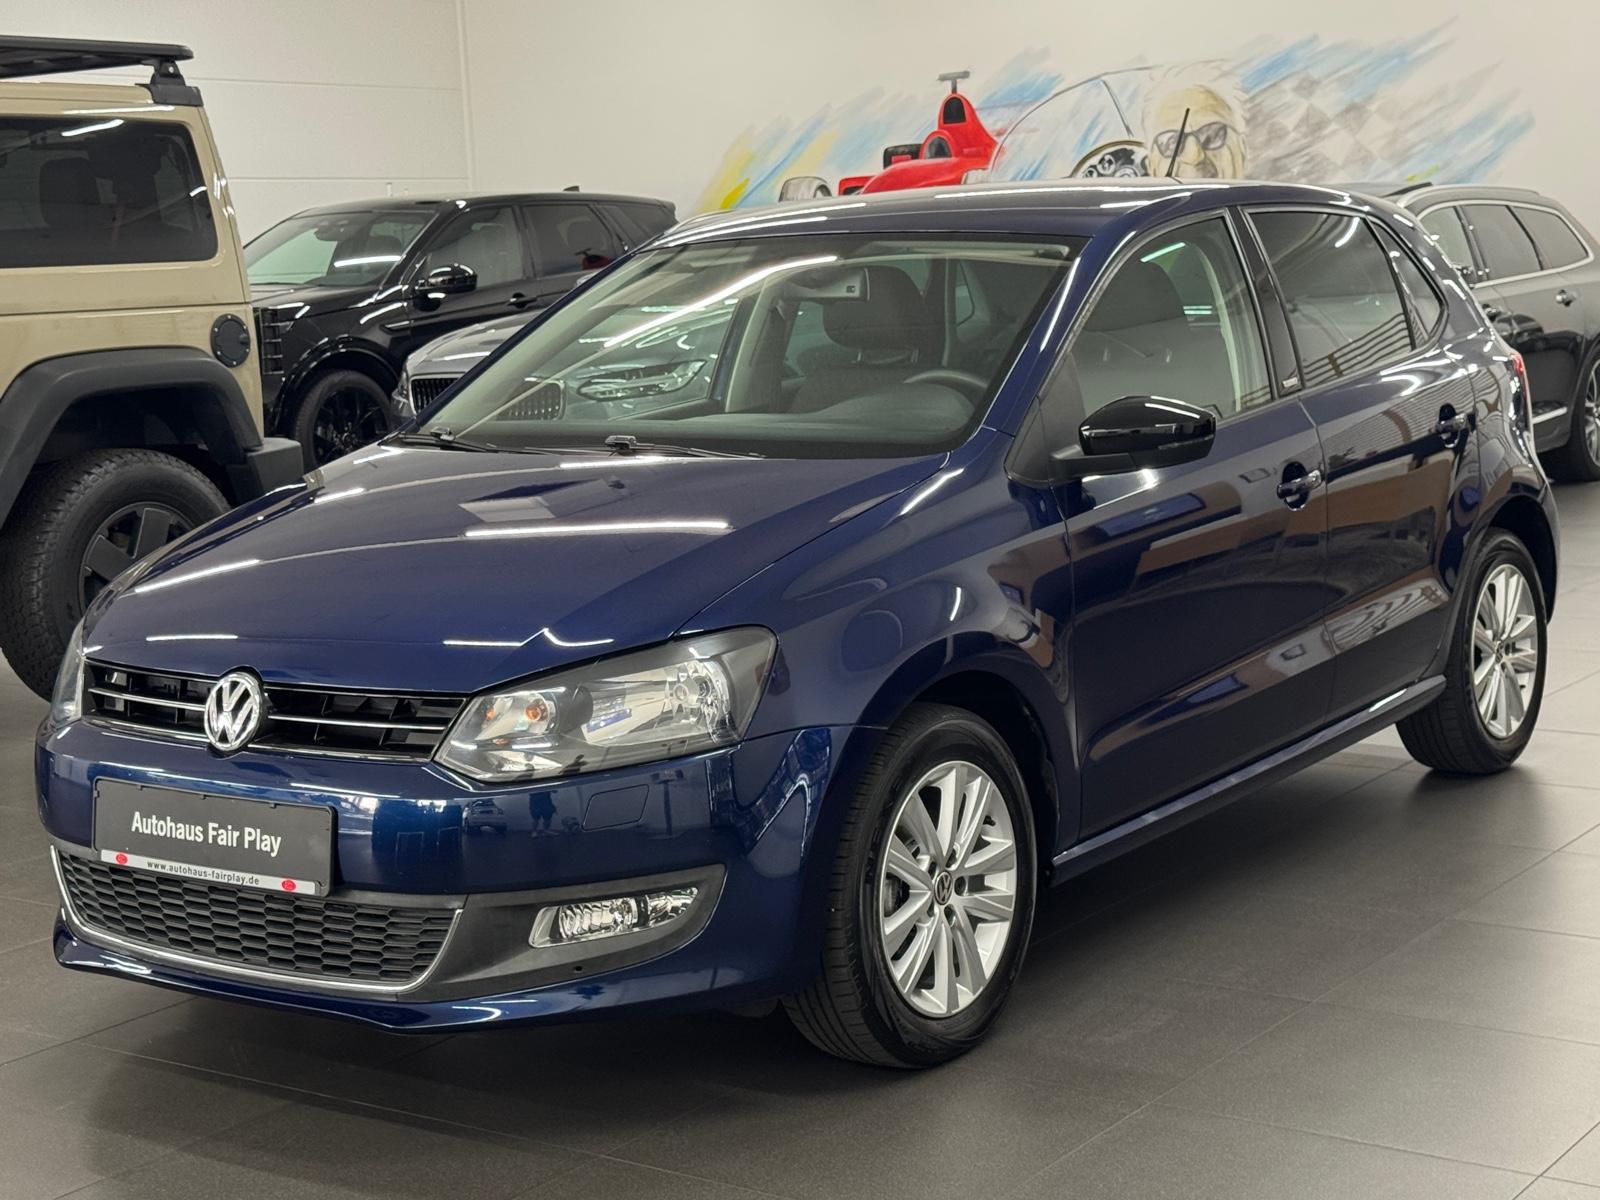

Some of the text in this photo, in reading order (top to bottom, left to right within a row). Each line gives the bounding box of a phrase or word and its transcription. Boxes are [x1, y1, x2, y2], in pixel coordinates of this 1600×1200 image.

[206, 676, 257, 747] VW
[131, 811, 281, 857] Autohaus Fair Play
[147, 861, 260, 885] www.autohaus-fairplay.de
